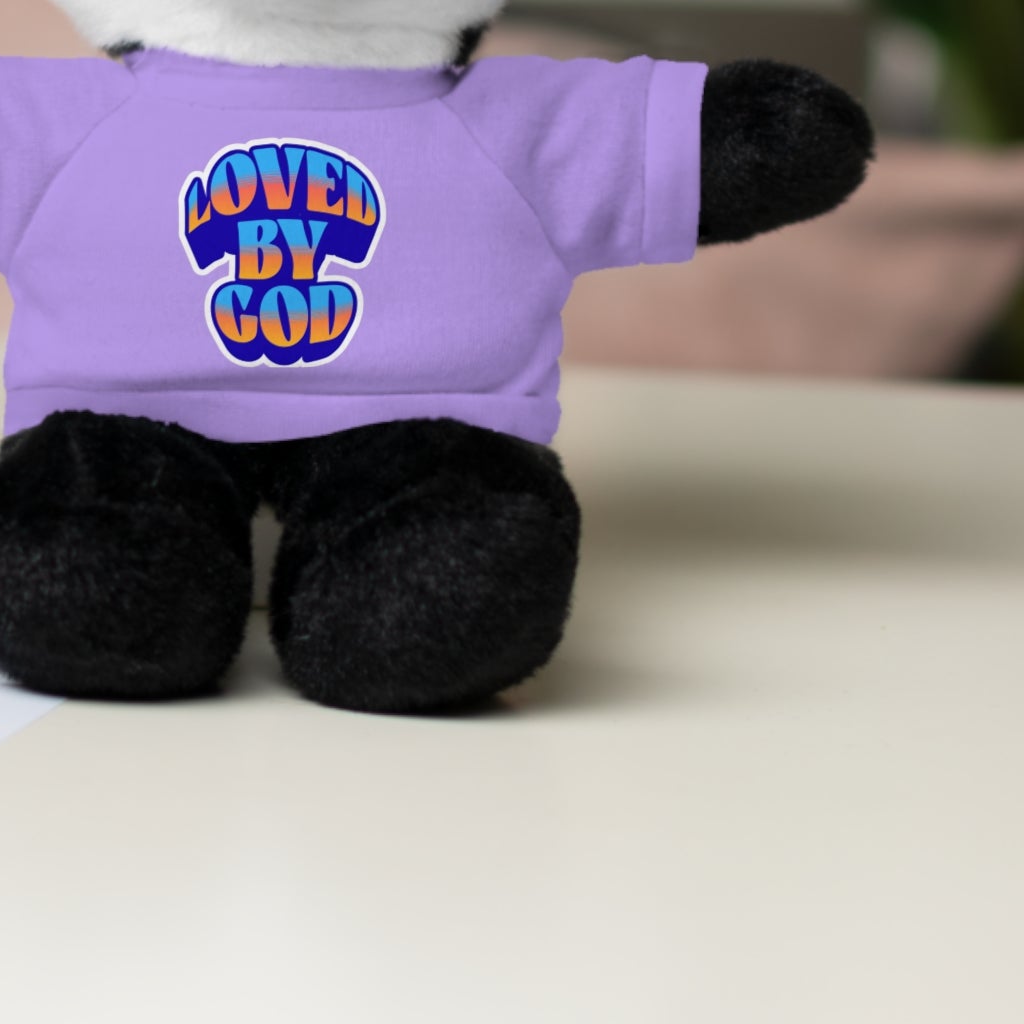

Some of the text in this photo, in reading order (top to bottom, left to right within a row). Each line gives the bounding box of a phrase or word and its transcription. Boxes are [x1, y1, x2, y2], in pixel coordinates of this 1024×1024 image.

[188, 146, 377, 233] LOVED
[237, 219, 329, 280] BY
[214, 284, 354, 347] GOD
